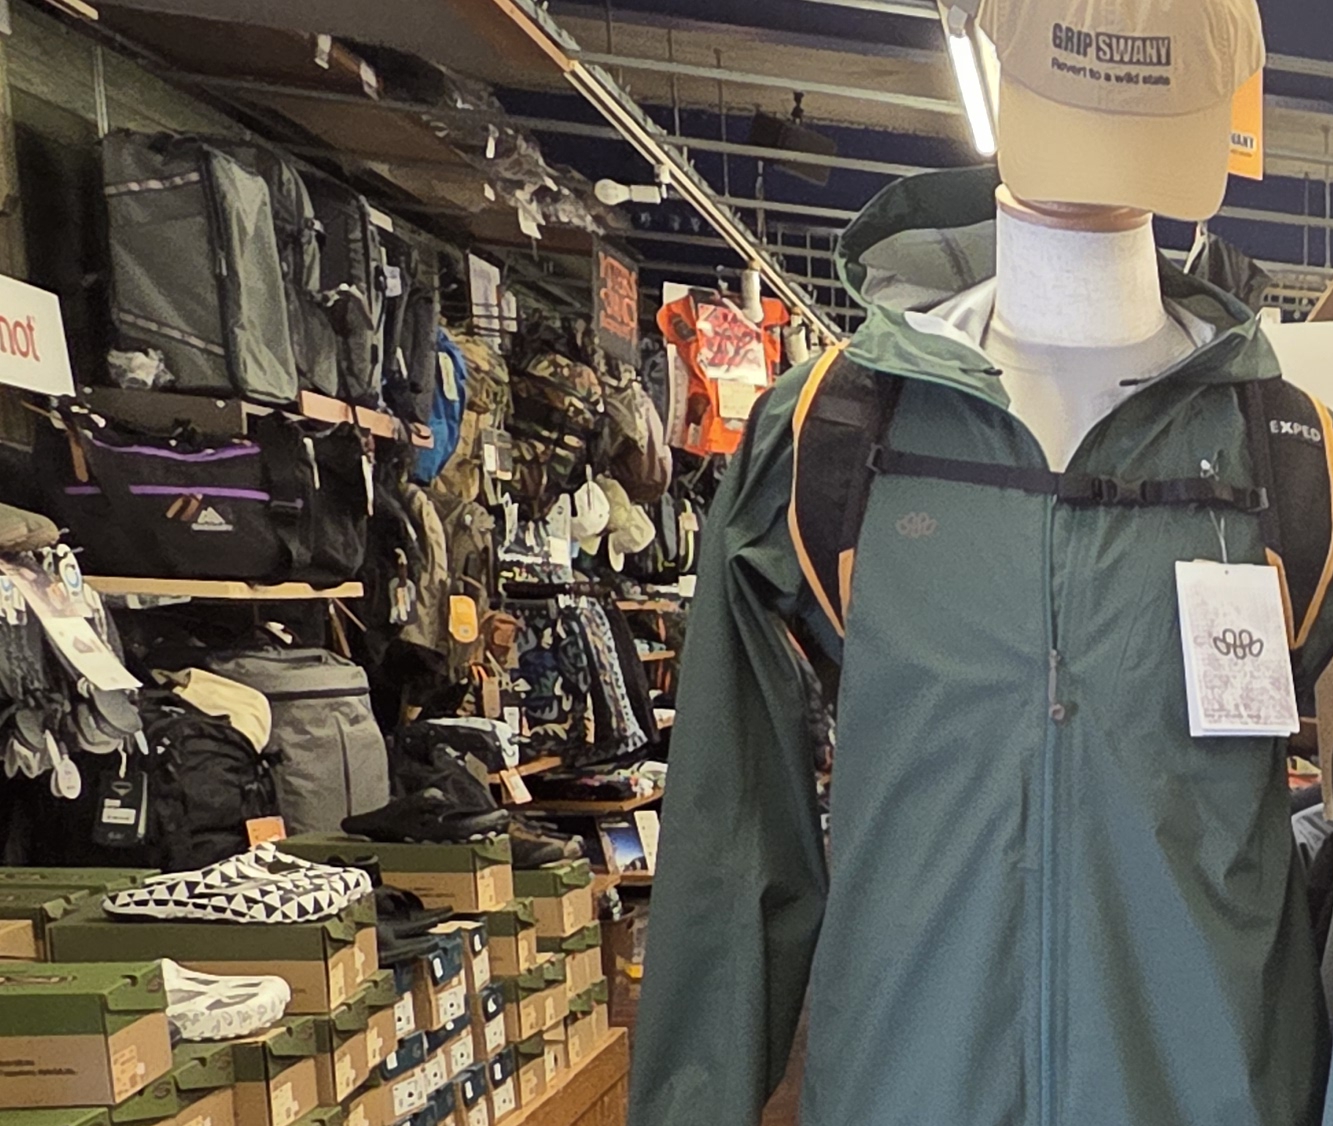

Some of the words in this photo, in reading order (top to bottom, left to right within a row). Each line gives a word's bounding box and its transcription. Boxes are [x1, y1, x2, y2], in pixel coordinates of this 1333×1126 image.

[1052, 23, 1092, 57] GRIP
[1099, 34, 1170, 65] SWANY
[1089, 67, 1101, 81] to
[1104, 71, 1112, 82] a
